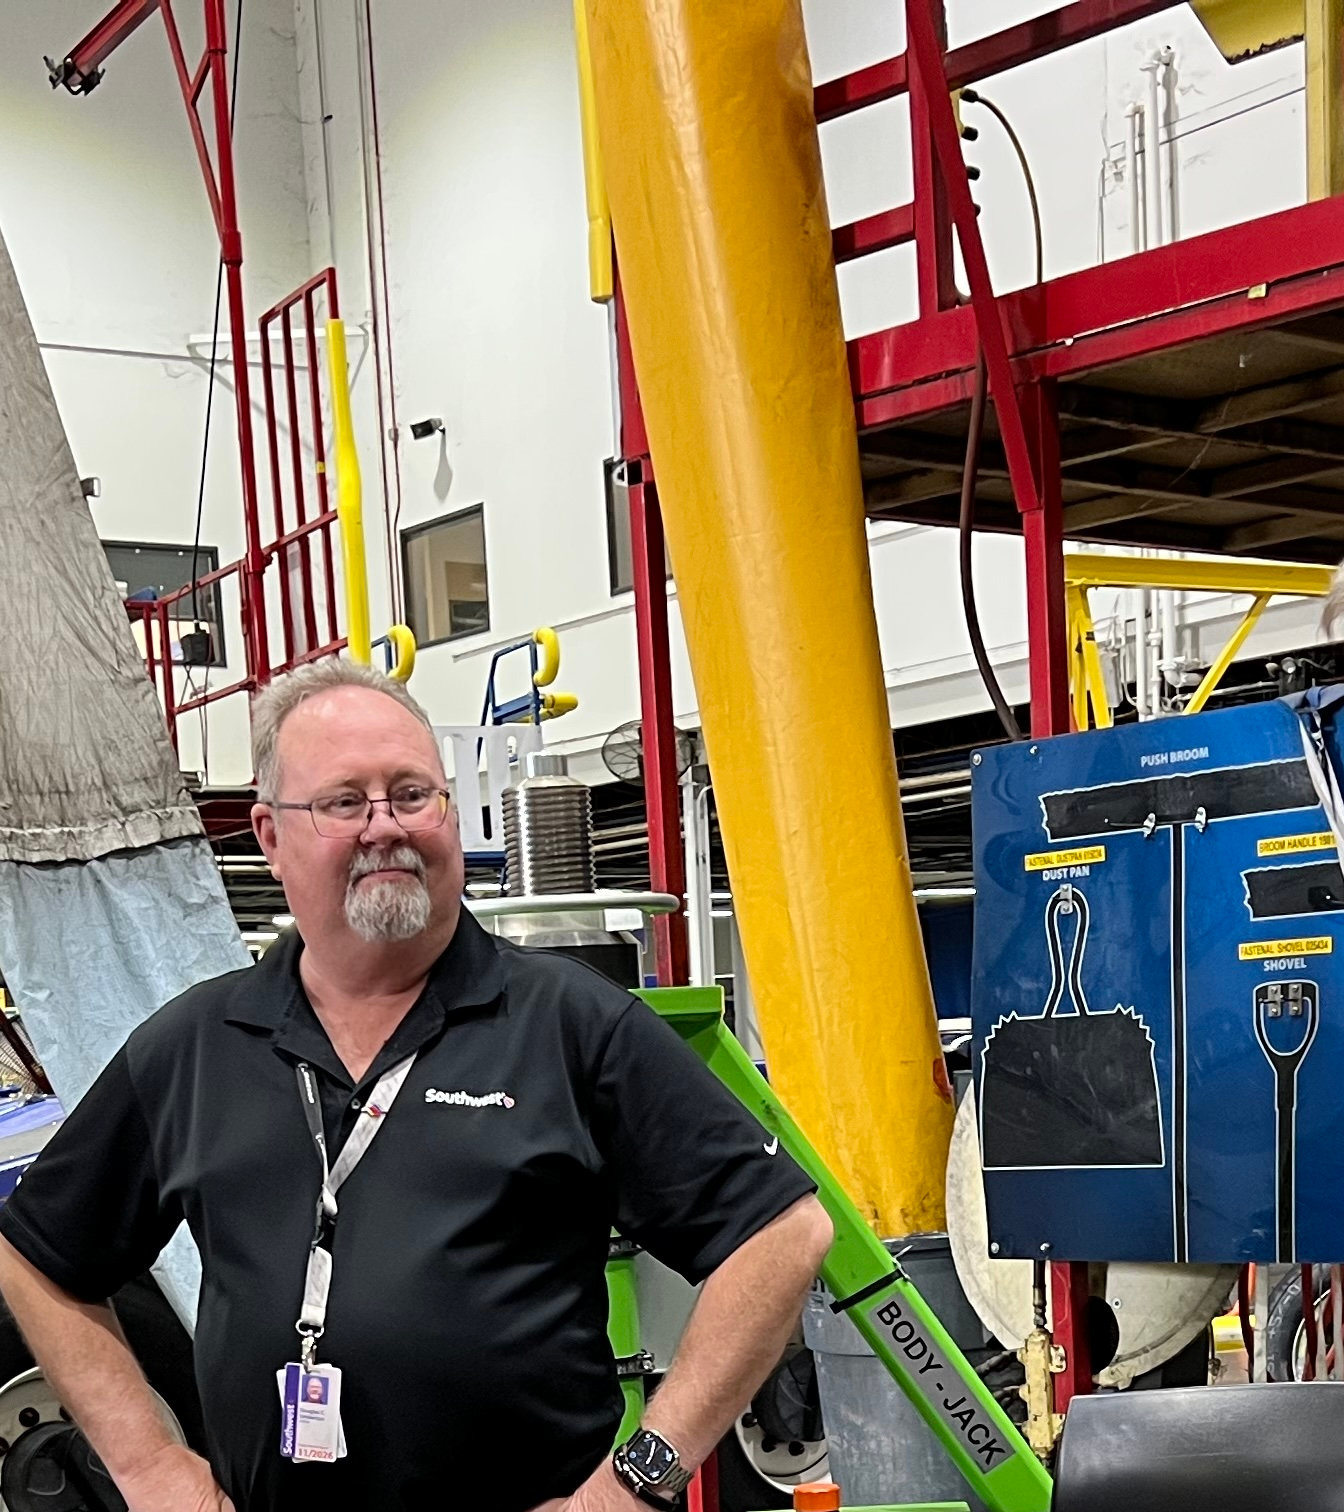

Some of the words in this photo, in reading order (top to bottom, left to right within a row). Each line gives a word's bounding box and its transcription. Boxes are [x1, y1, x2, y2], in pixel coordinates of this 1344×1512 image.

[1140, 752, 1169, 767] PUSH
[1169, 747, 1209, 763] BROOM
[1287, 835, 1317, 848] HANDLE
[1042, 867, 1069, 881] DUST
[1069, 865, 1091, 879] PAN
[1276, 941, 1305, 954] SHOVEL
[1263, 957, 1308, 972] SHOVEL
[424, 1087, 506, 1107] Southwest
[877, 1300, 943, 1375] BODY
[943, 1396, 1006, 1466] JACK
[282, 1404, 296, 1454] Southwest
[298, 1447, 335, 1460] 11/2026
